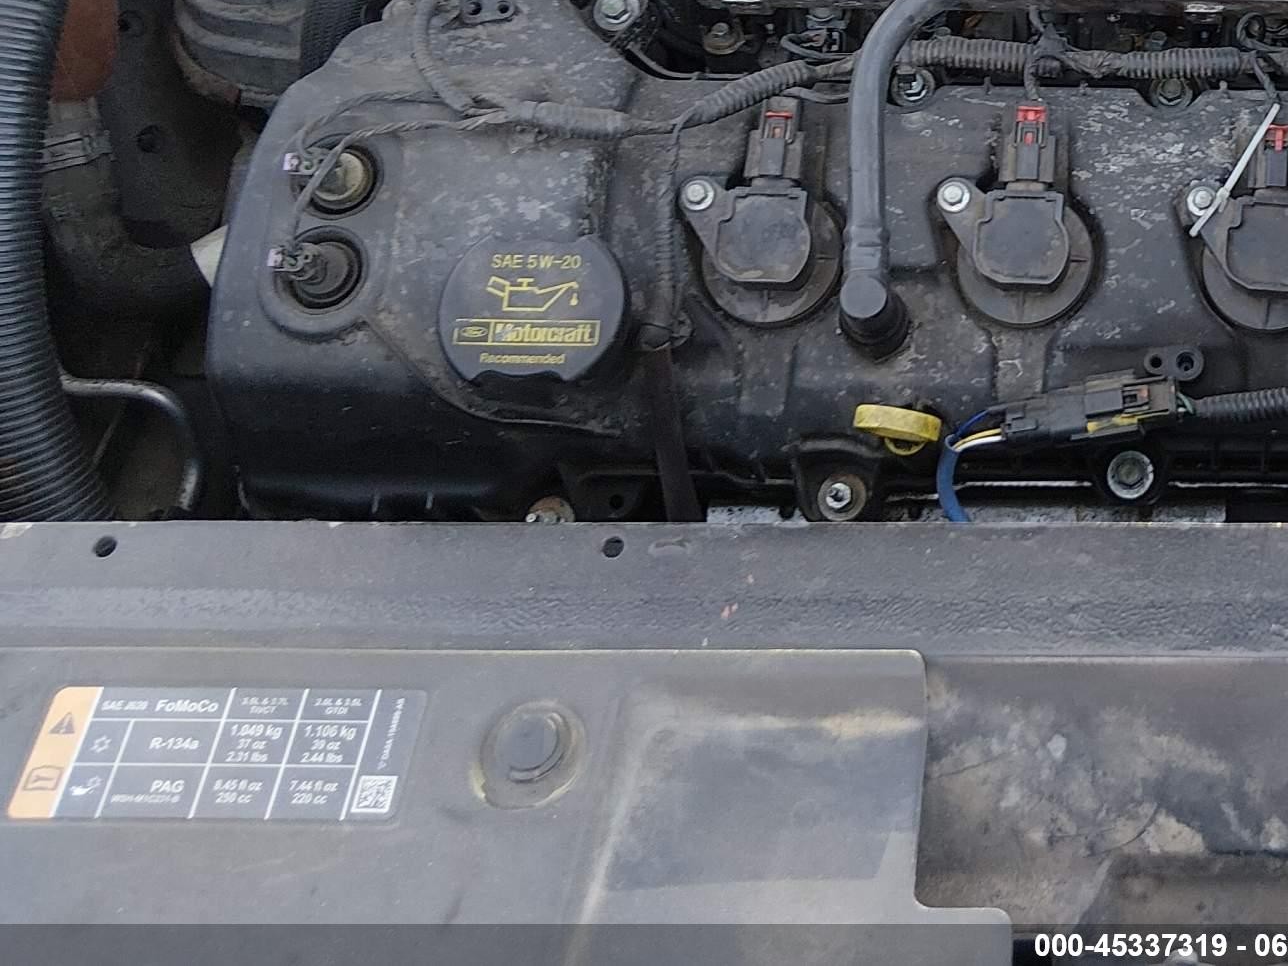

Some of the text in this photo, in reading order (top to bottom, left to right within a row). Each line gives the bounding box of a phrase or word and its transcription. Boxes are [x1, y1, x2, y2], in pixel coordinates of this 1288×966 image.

[490, 254, 582, 268] SAE 5W-20
[494, 322, 593, 343] Motorcraft
[479, 352, 566, 364] Recommended
[154, 699, 219, 713] FoMoCo
[231, 723, 283, 740] 1.049 kg
[304, 725, 357, 741] 1.106 kg
[149, 736, 201, 750] R-134a
[236, 739, 267, 750] 37 oz
[310, 739, 341, 750] 39 oz
[225, 751, 269, 762] 2.31 lbs
[300, 752, 343, 763] 2.44 lbs
[149, 779, 185, 793] PAG
[248, 782, 263, 792] oz
[323, 782, 338, 792] oz
[215, 792, 252, 803] 250 cc
[291, 793, 327, 804] 220 cc
